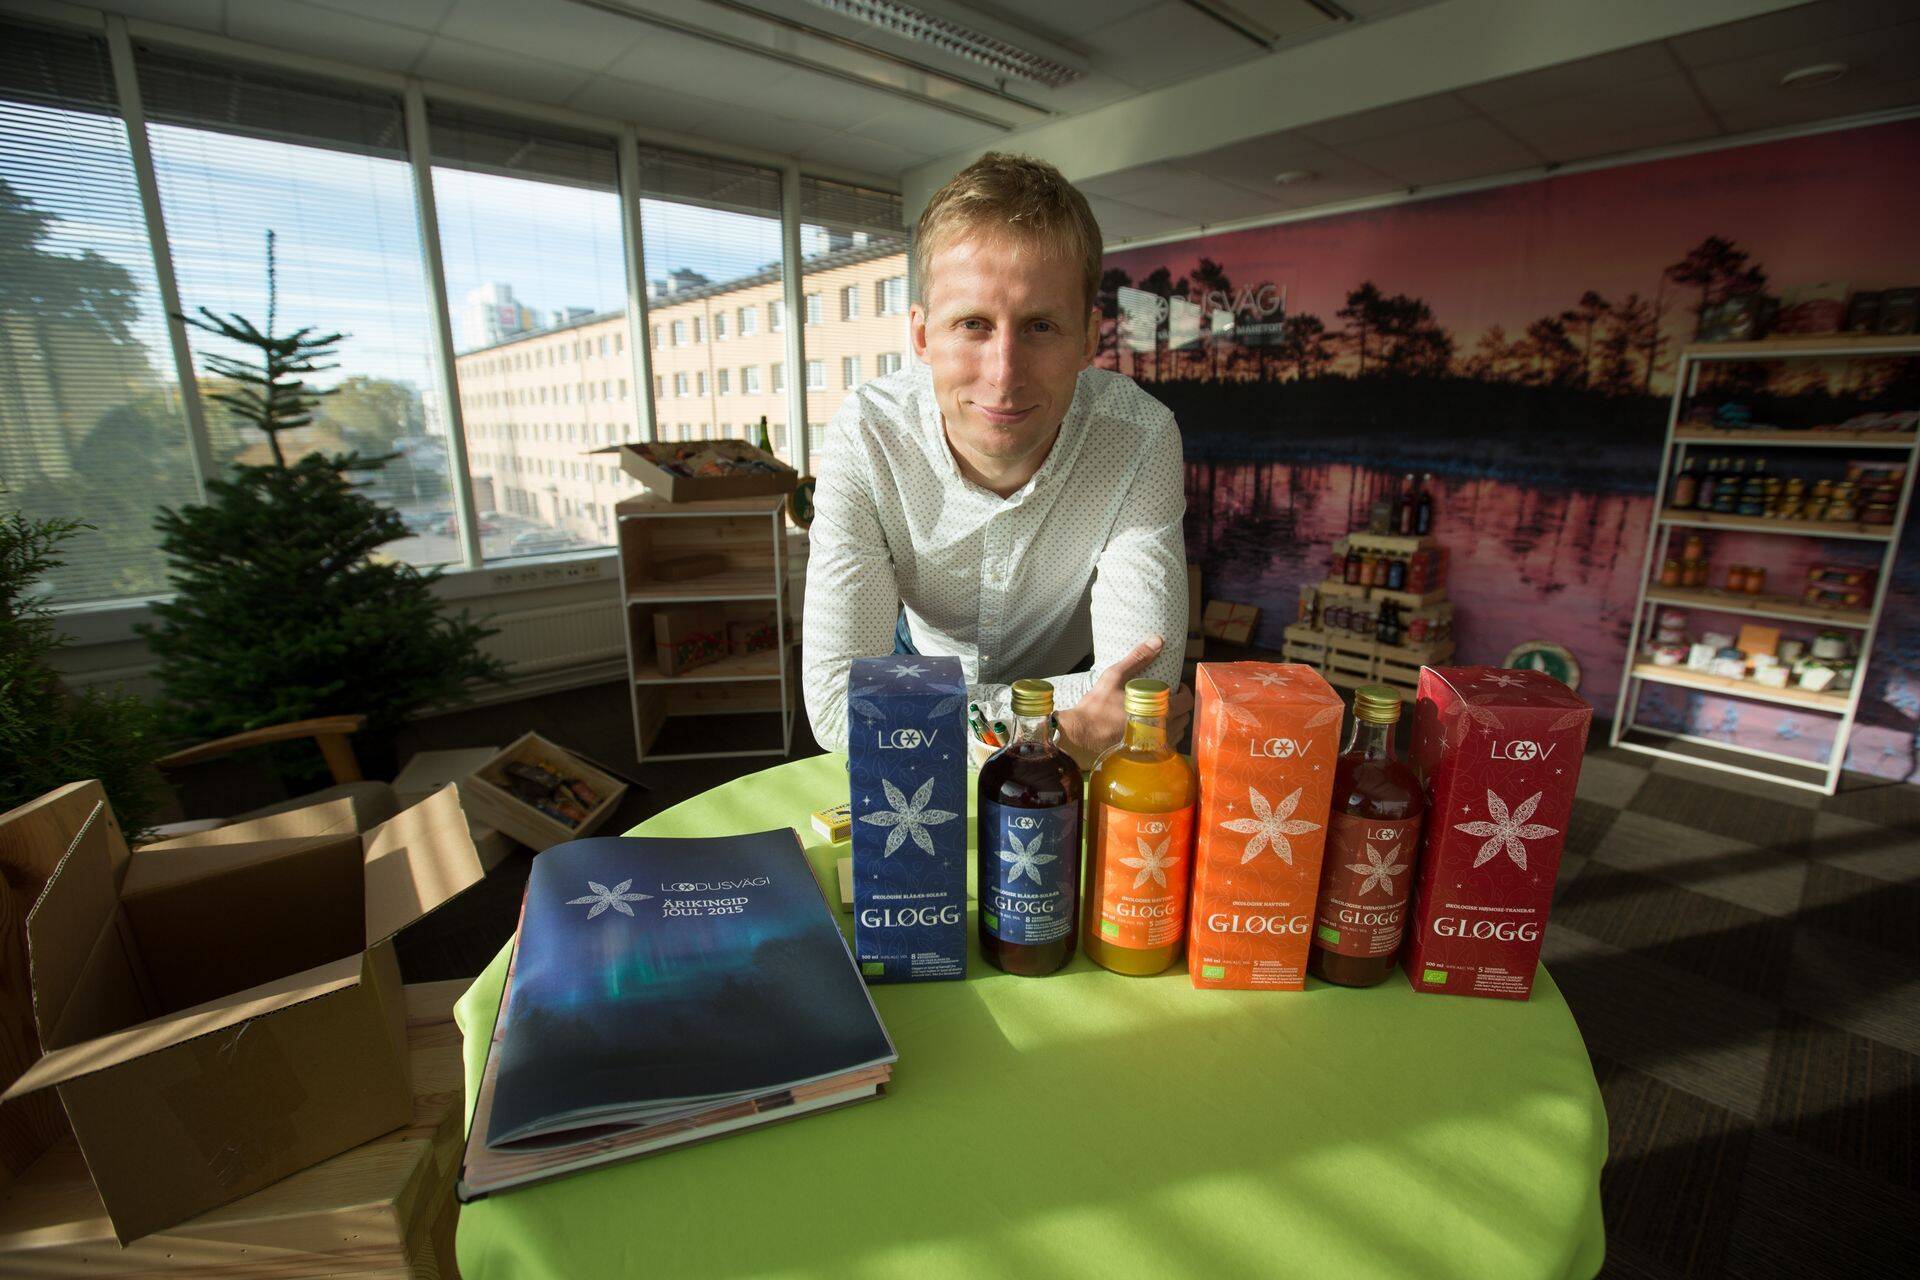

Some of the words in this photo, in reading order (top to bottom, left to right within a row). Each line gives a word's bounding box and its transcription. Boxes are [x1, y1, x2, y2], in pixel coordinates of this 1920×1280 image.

[878, 729, 938, 749] LOOV
[1250, 738, 1313, 760] LOOV
[1491, 739, 1556, 762] LOOV
[1008, 815, 1044, 830] LOOV
[1137, 820, 1173, 834] LOOV
[1367, 827, 1404, 841] LOOV
[661, 876, 771, 892] LOODUSVÄGI
[662, 897, 749, 909] ÄRIKINGID
[708, 905, 744, 915] 2015
[860, 905, 961, 928] GLØGG
[1208, 913, 1310, 935] GLØGG
[1433, 916, 1540, 942] GLØGG
